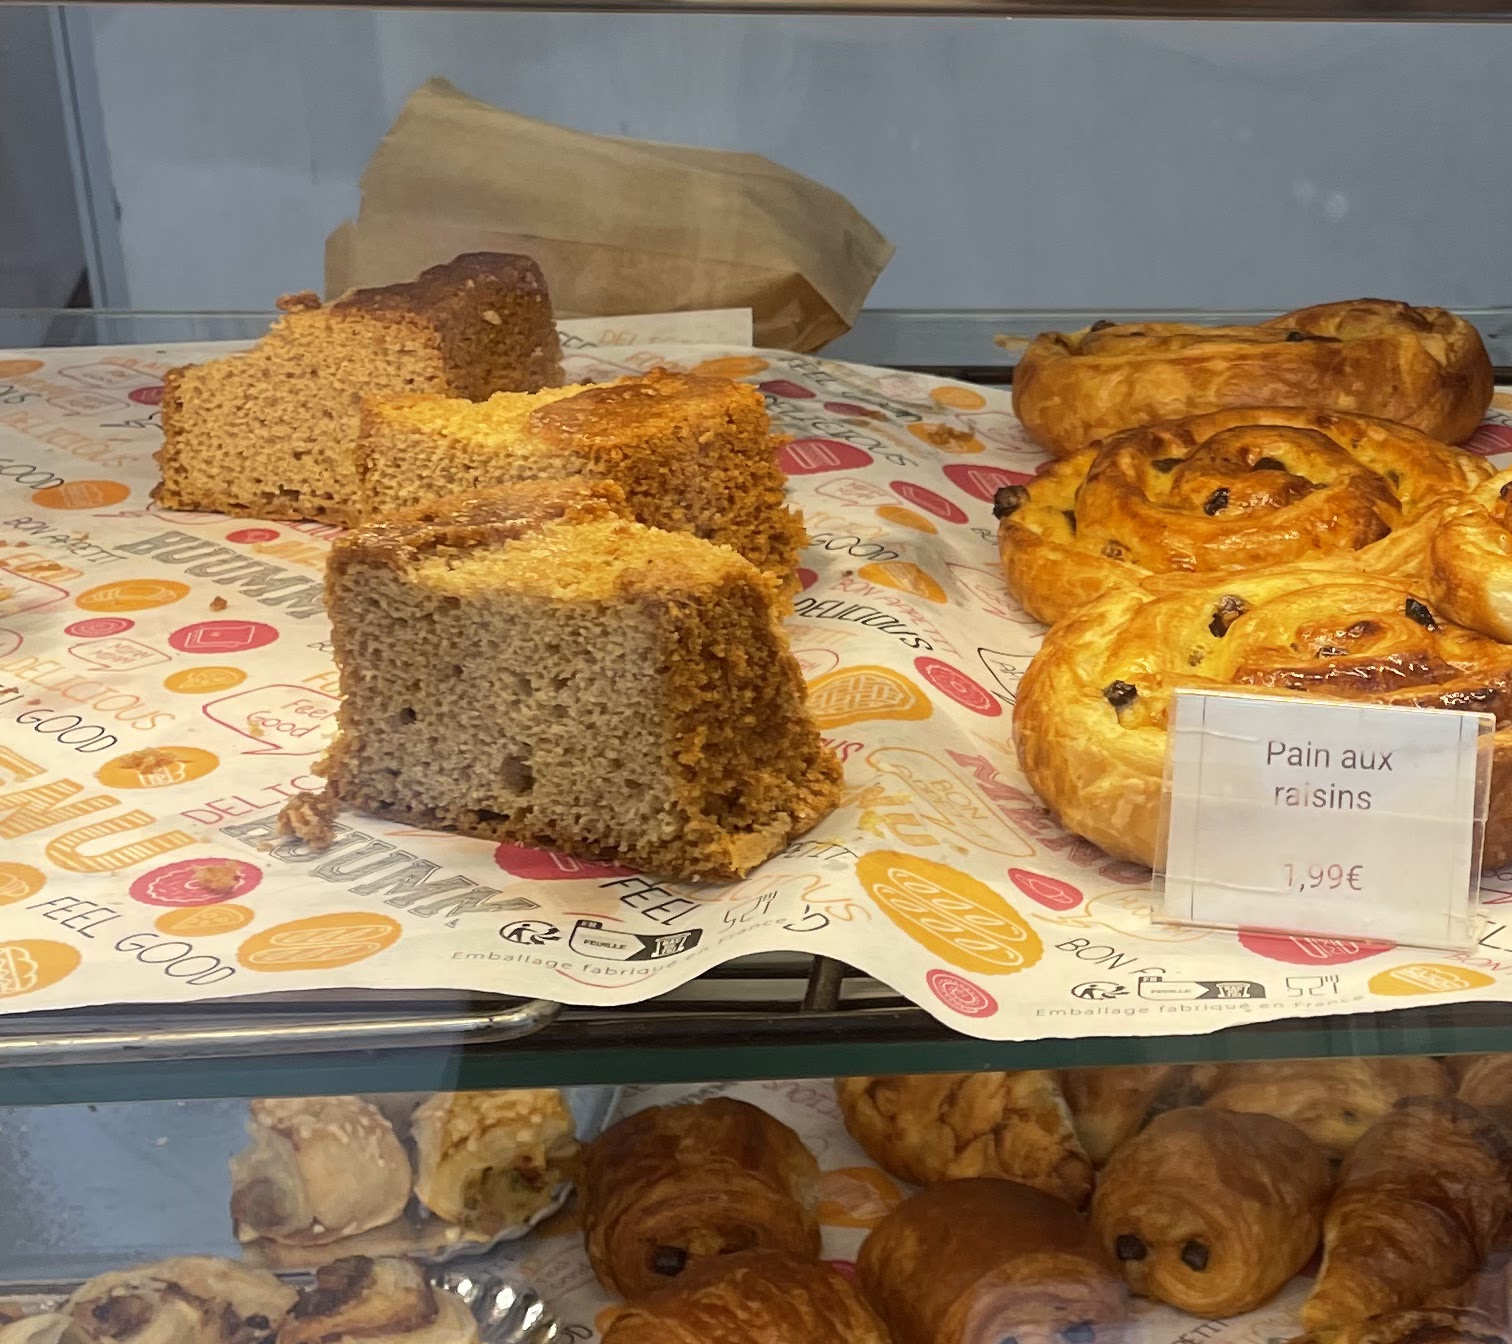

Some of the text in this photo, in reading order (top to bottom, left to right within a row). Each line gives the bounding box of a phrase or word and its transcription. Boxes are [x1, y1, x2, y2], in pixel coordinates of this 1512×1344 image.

[0, 459, 64, 490] OOD
[808, 533, 899, 561] GOOD
[794, 598, 934, 651] DELICIOUS
[16, 709, 118, 753] GOOD
[1266, 739, 1394, 771] Pain aux
[1273, 782, 1372, 811] raisins
[1282, 863, 1364, 892] 1,99€
[599, 877, 702, 926] FEEL
[26, 896, 237, 986] FEEL GOOD
[1056, 937, 1139, 970] BON
[452, 950, 573, 971] Emballage
[1036, 1005, 1149, 1017] Emballage
